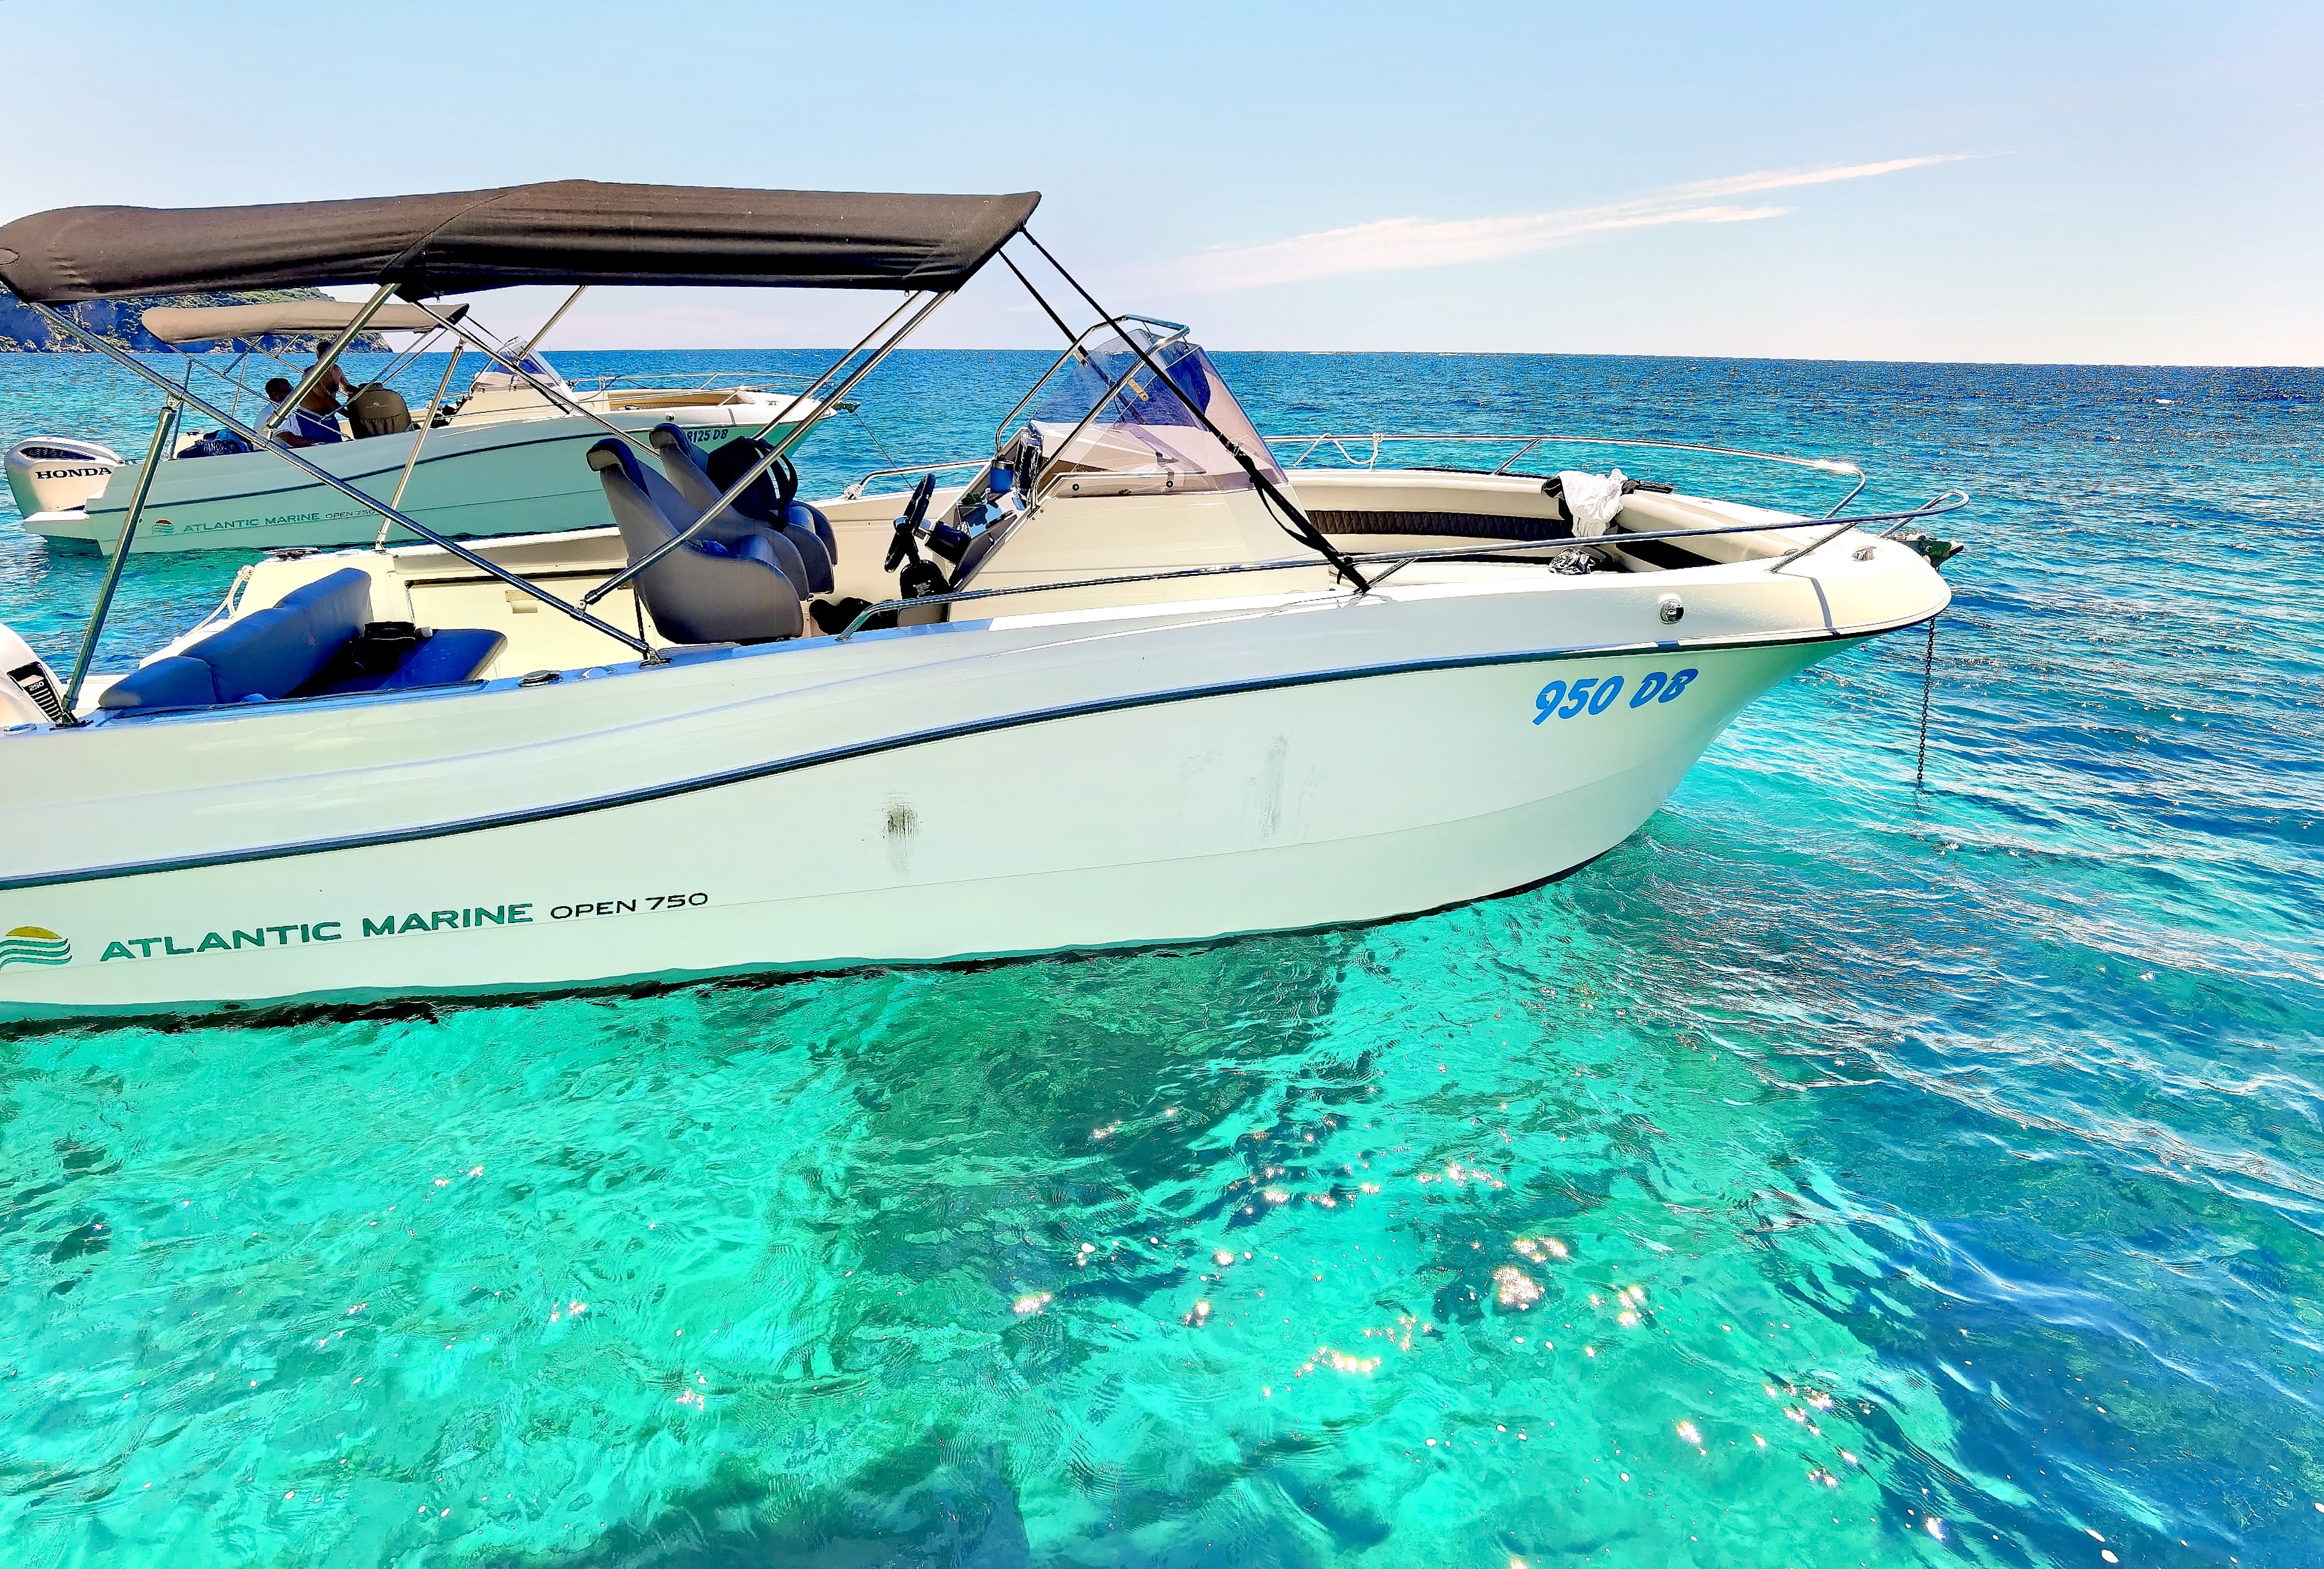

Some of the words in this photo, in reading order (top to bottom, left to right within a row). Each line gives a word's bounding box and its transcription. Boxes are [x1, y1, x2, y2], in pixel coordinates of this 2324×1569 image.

[713, 429, 729, 440] DB
[35, 467, 112, 479] HONDA
[184, 519, 259, 532] ATLANTIC
[265, 513, 319, 524] MARINE
[29, 681, 44, 691] 250
[1533, 675, 1624, 725] 950
[1629, 668, 1698, 709] DB
[100, 922, 341, 962] ATLANTIC
[363, 903, 533, 937] MARINE
[550, 899, 636, 919] OPEN
[645, 892, 708, 910] 750
